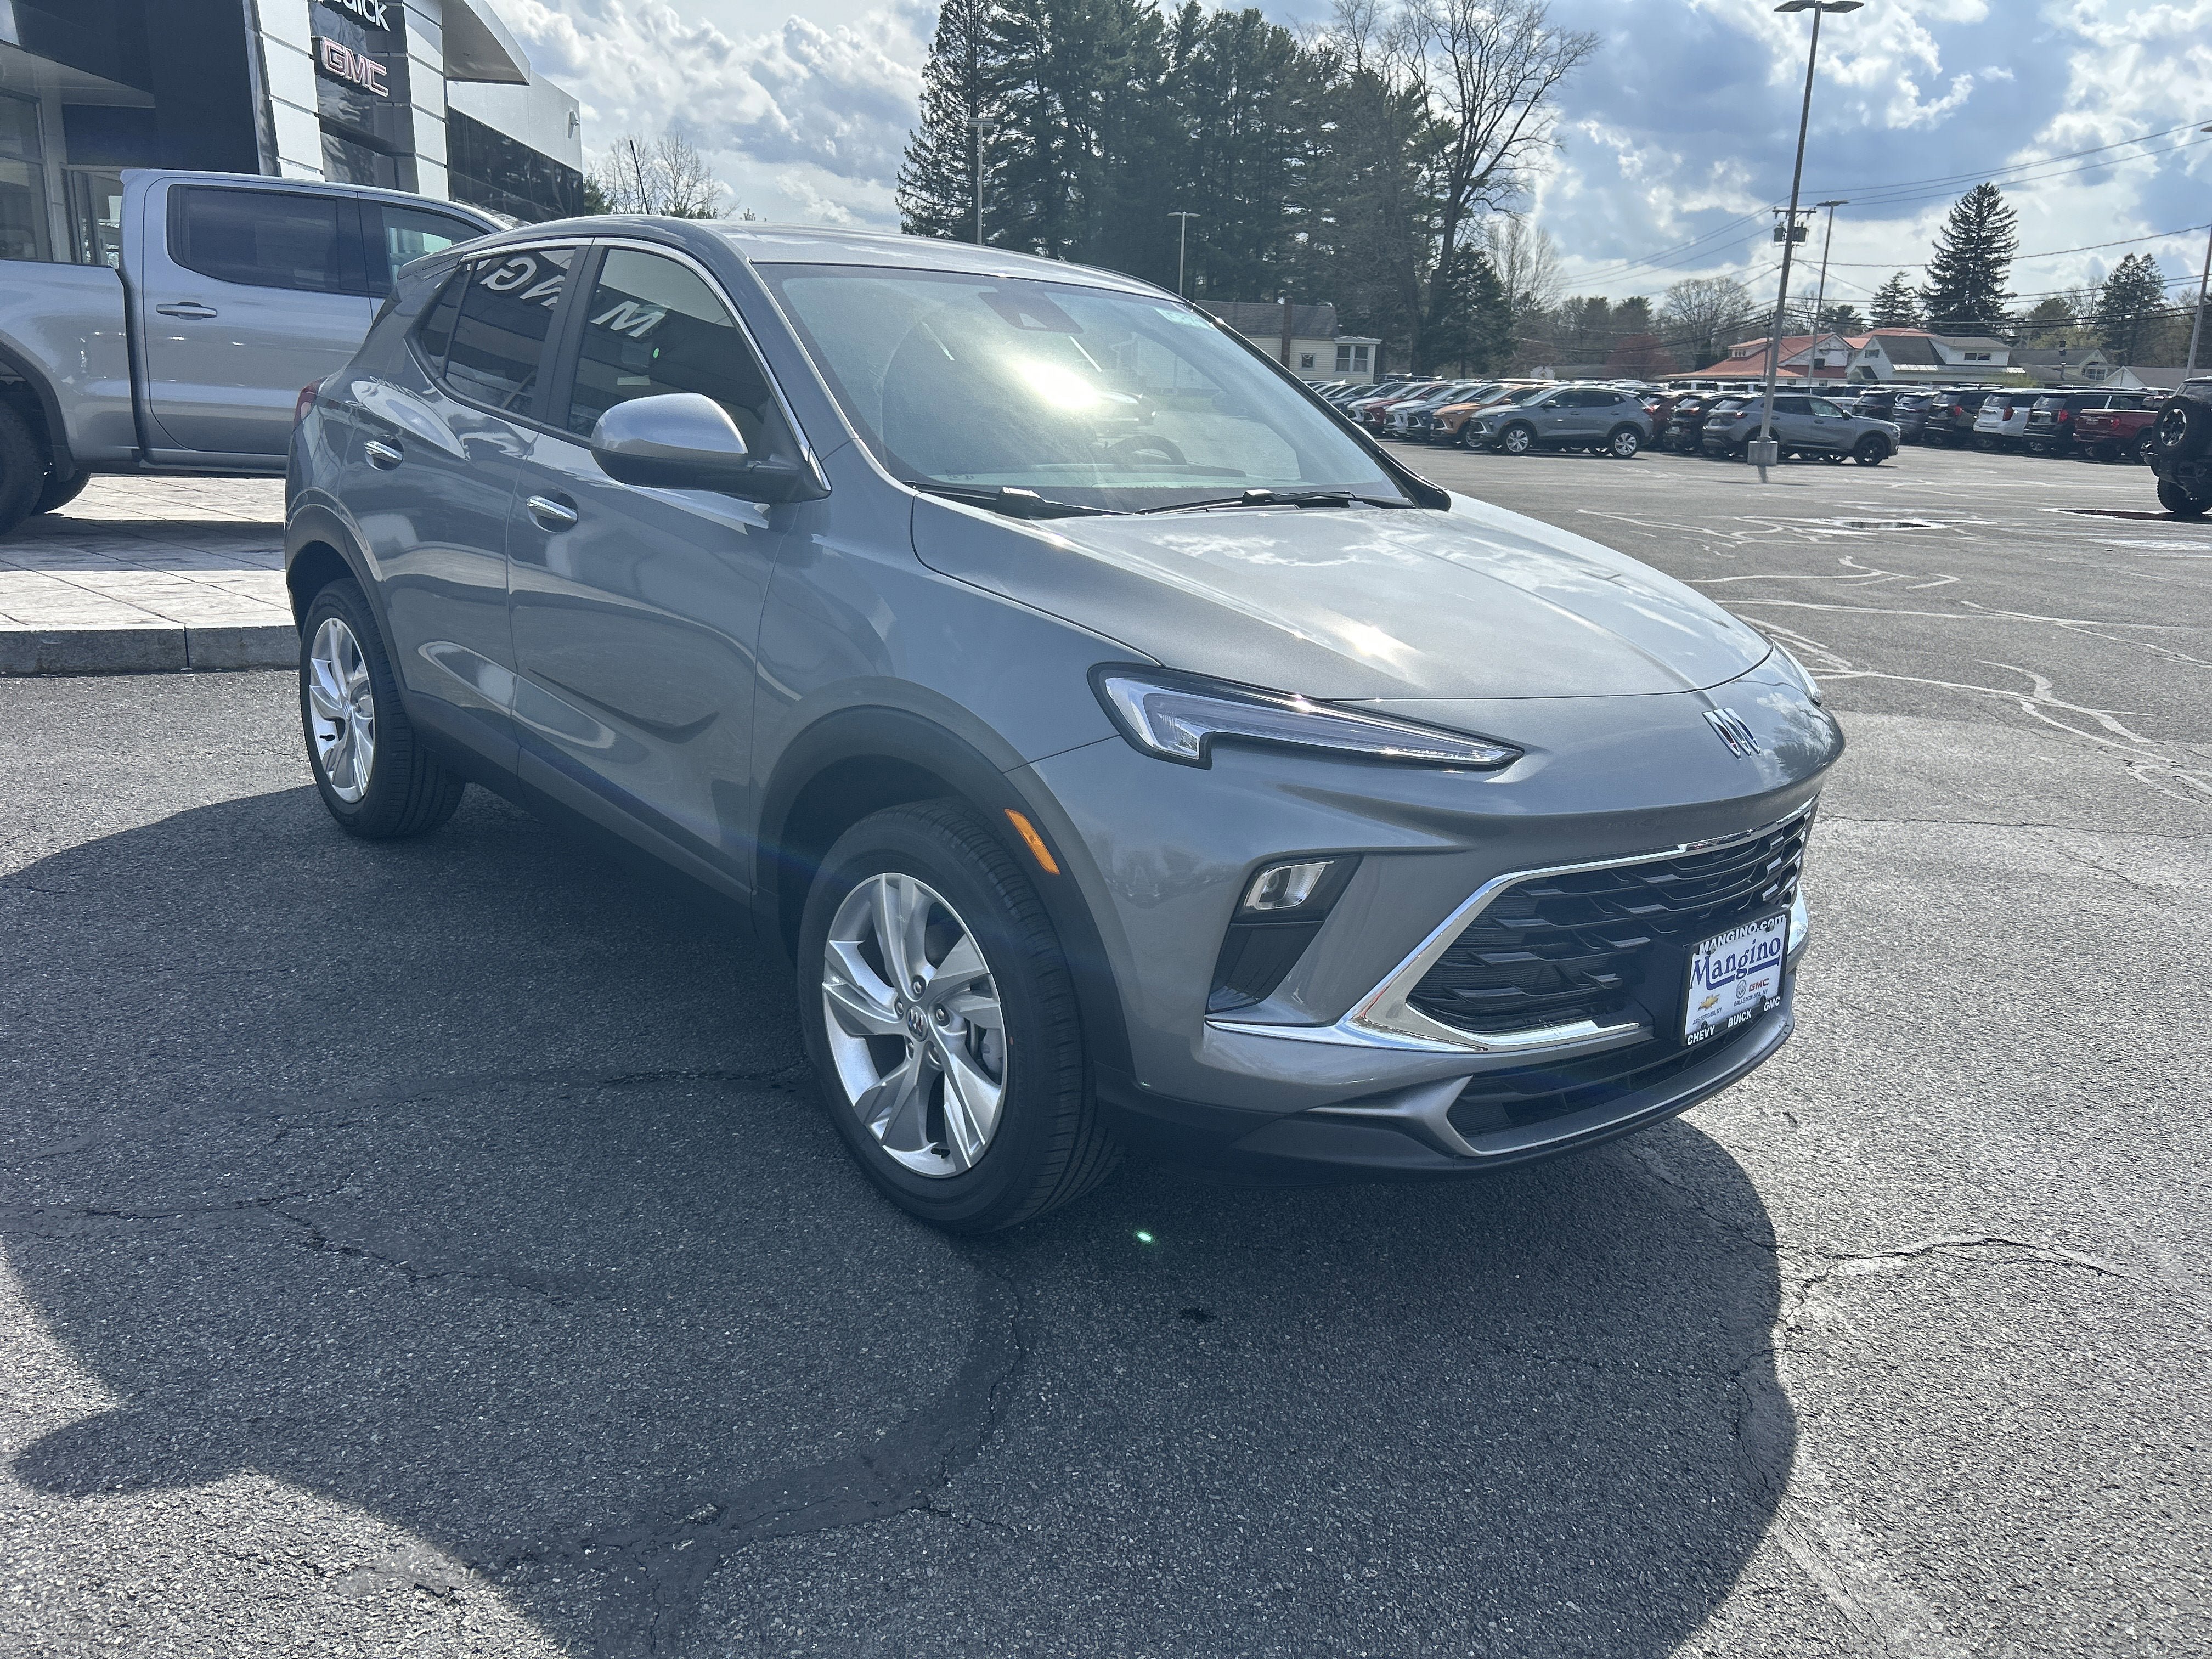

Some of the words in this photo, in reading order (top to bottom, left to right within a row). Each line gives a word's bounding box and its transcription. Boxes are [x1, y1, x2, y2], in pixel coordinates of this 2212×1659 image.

[334, 0, 391, 32] ICK
[320, 36, 389, 98] GMC
[1690, 937, 1781, 991] Mangino
[1749, 977, 1770, 992] GMC
[1734, 995, 1753, 1007] BALLSTON
[1763, 996, 1781, 1012] GMC
[1728, 1008, 1752, 1028] BUICK
[1687, 1024, 1716, 1046] CHEVY
